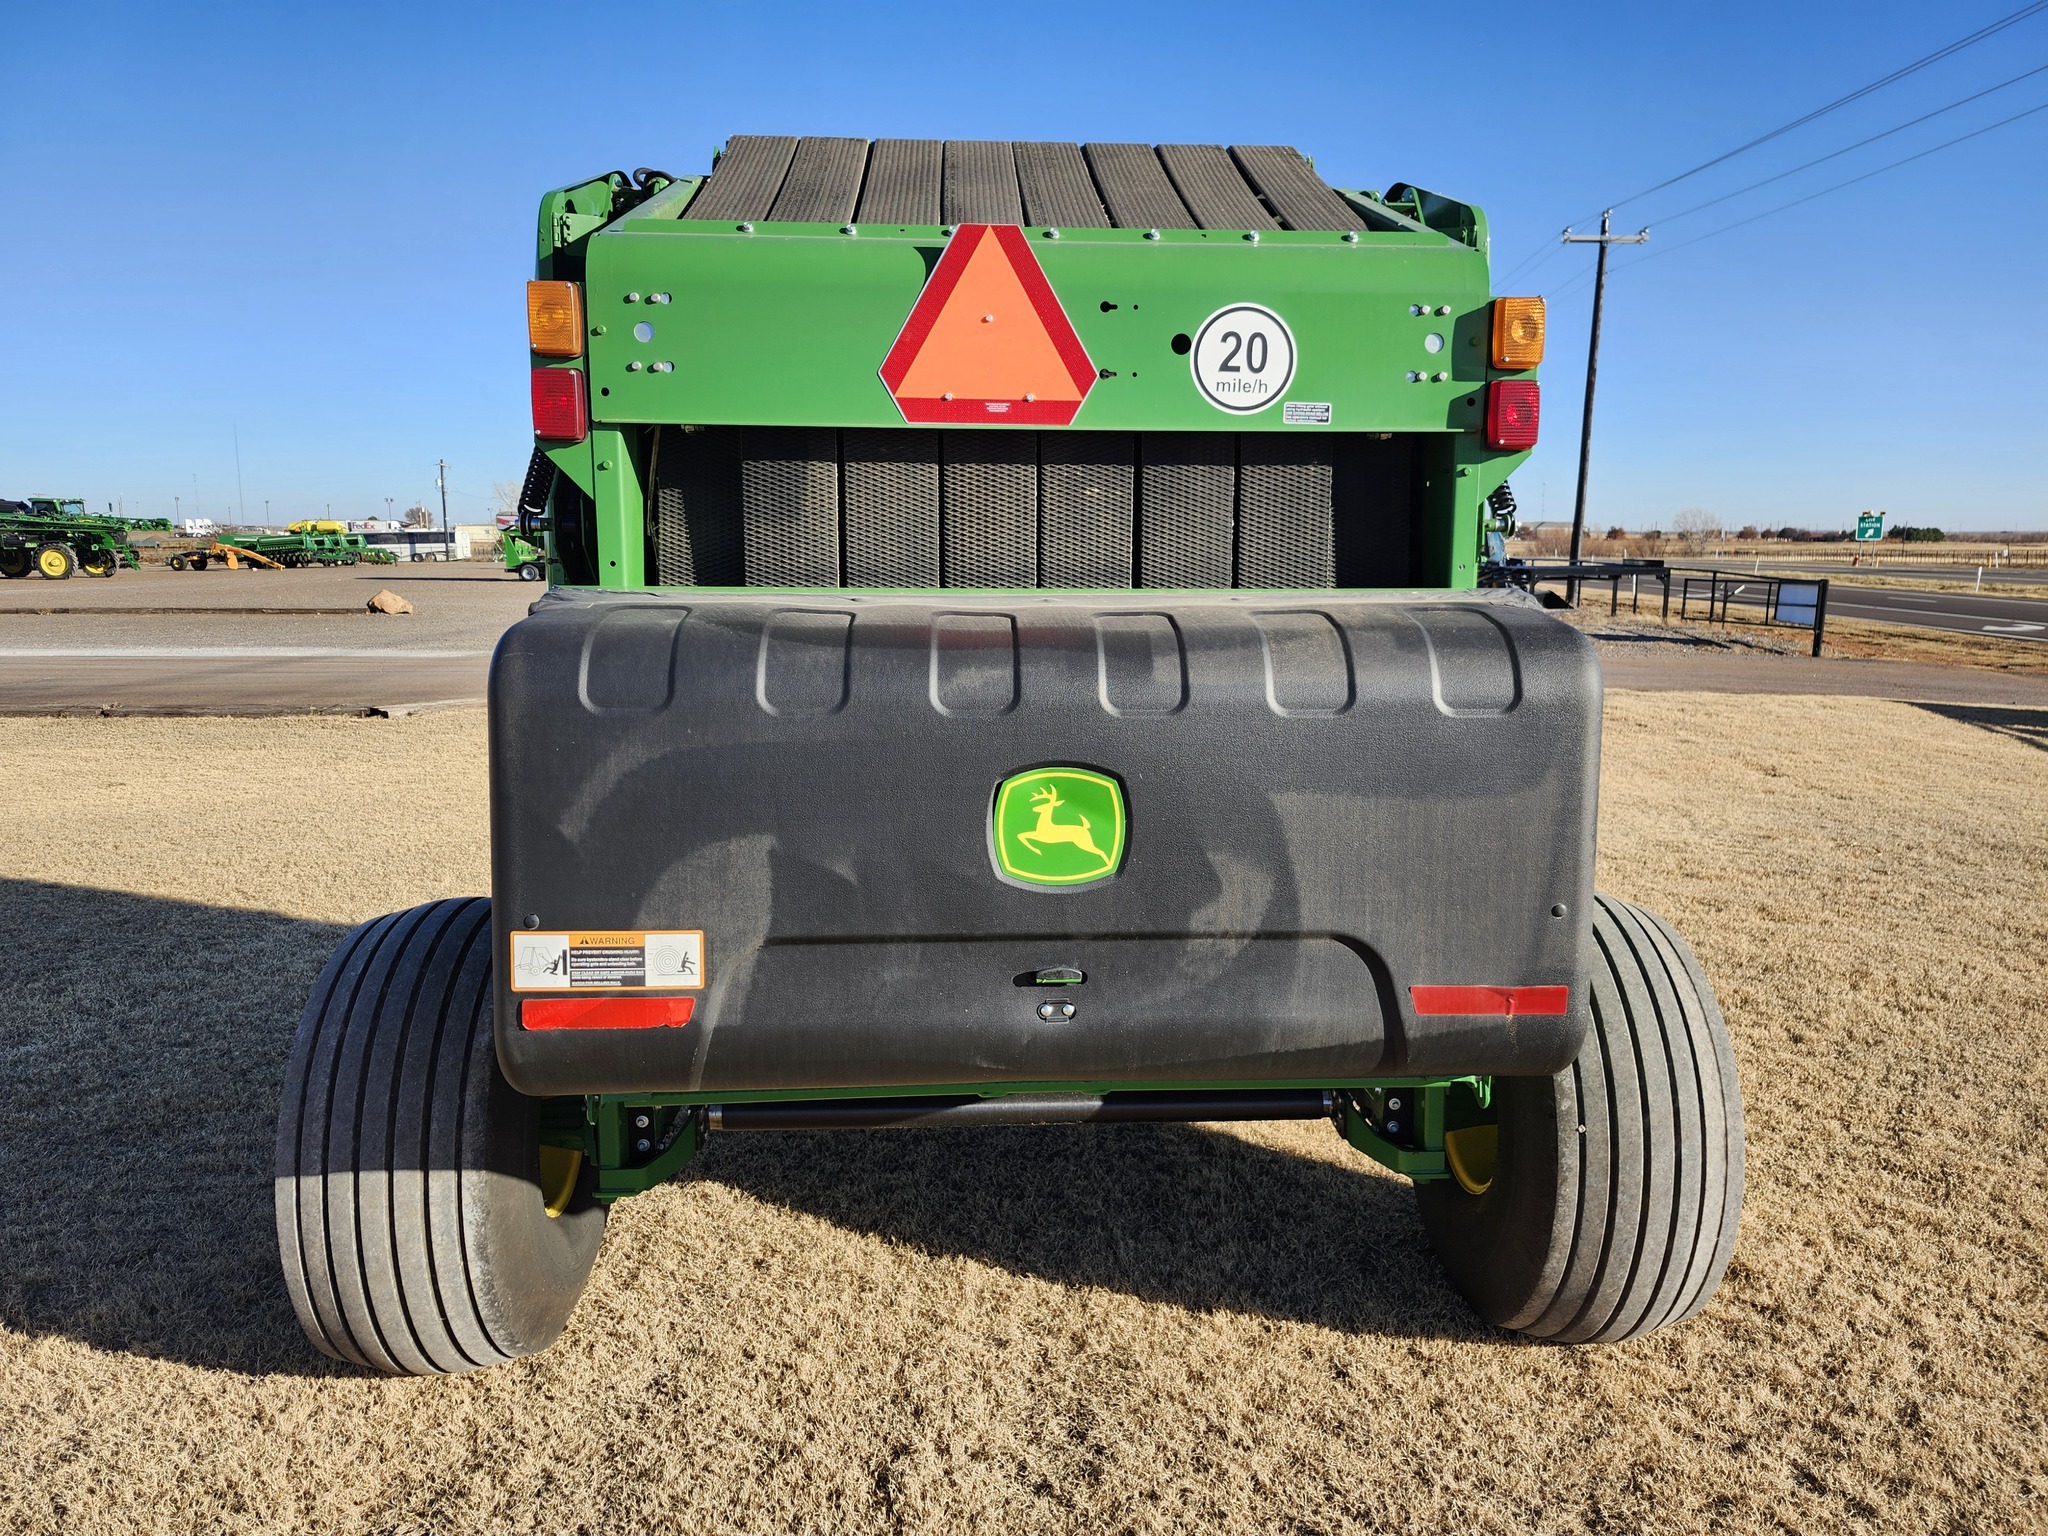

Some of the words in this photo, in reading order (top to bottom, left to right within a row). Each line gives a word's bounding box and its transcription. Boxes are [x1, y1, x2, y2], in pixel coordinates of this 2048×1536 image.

[1218, 330, 1268, 374] 20
[1216, 378, 1268, 394] mile/h
[589, 937, 635, 945] WARNING
